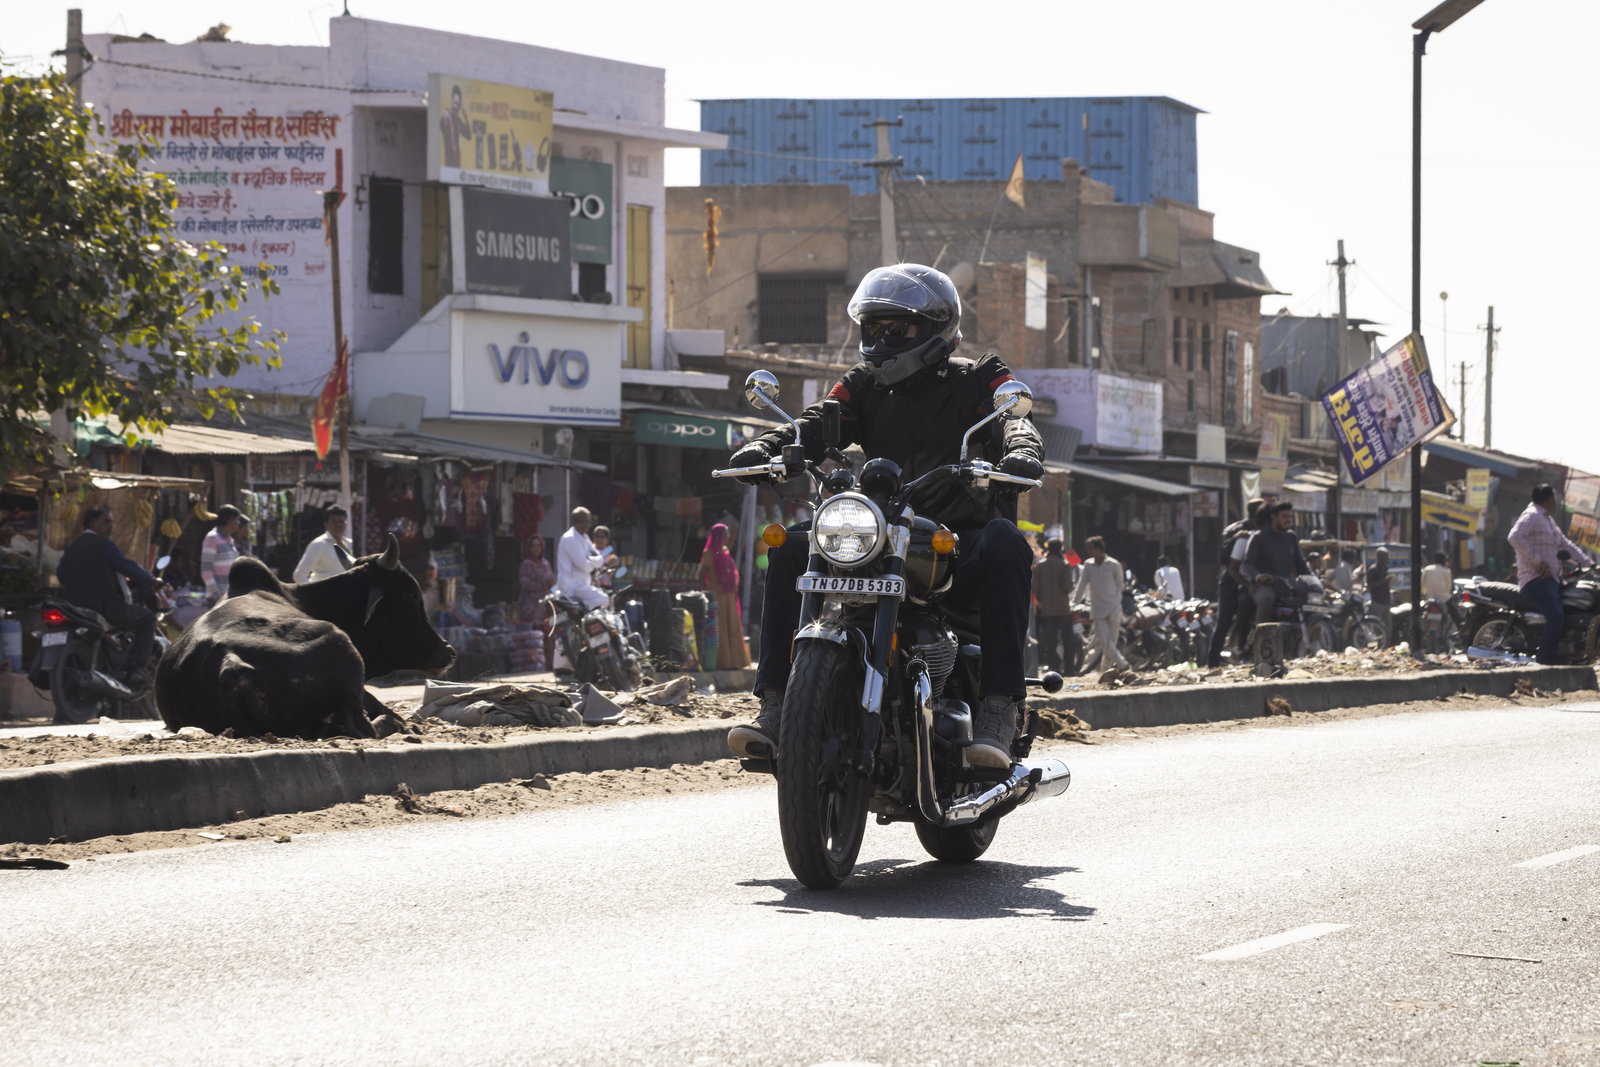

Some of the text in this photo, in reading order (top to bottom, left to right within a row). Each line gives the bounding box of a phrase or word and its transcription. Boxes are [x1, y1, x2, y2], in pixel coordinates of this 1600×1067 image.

[169, 107, 236, 144] मोबाईल
[275, 115, 288, 143] &
[198, 141, 209, 161] से
[212, 141, 256, 163] मोबाईल
[258, 140, 281, 160] फोन
[189, 166, 229, 187] मोबाईल
[243, 167, 288, 189] म्यूजिक
[290, 166, 326, 187] सिस्टम
[197, 190, 222, 208] जाते
[198, 216, 237, 235] मोबाईल
[476, 229, 560, 263] SAMSUNG
[487, 331, 590, 390] vivo
[648, 421, 716, 437] oppo
[1328, 388, 1375, 475] तेजस
[812, 578, 902, 593] TN 07DB 5383
